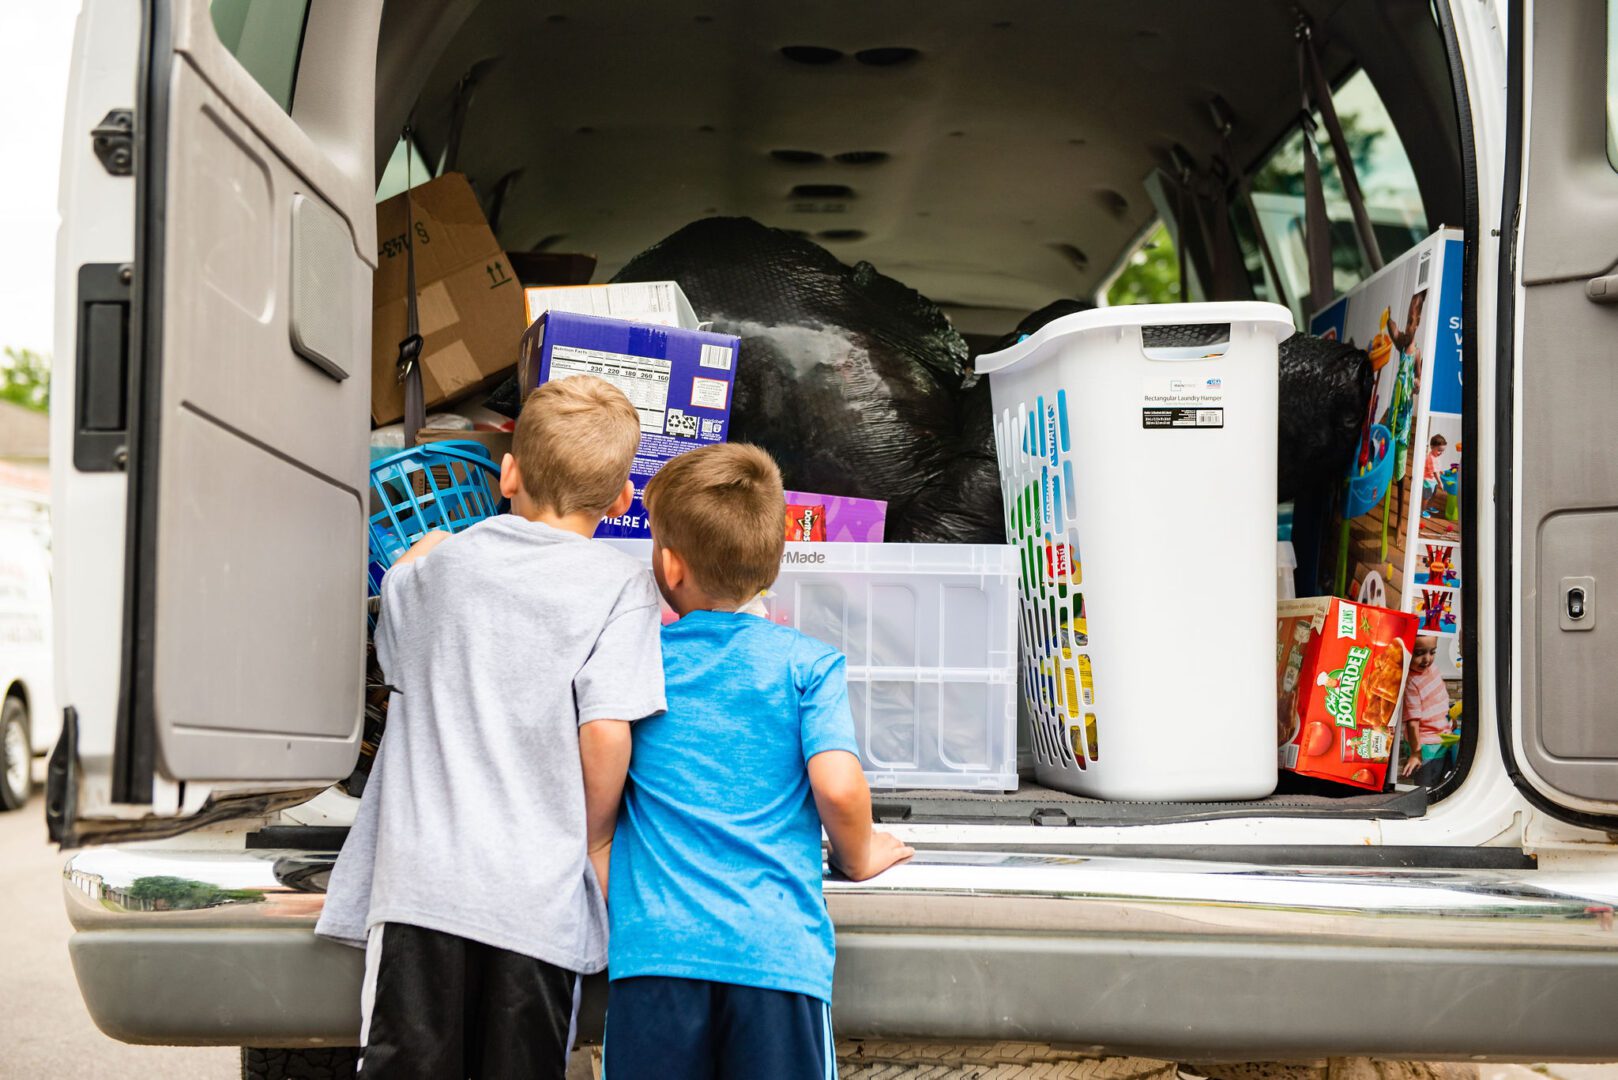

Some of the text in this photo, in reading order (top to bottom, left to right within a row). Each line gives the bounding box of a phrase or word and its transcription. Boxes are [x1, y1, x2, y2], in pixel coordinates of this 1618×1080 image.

[1342, 609, 1354, 634] 12 CANS
[1337, 647, 1369, 727] BOYARDEE
